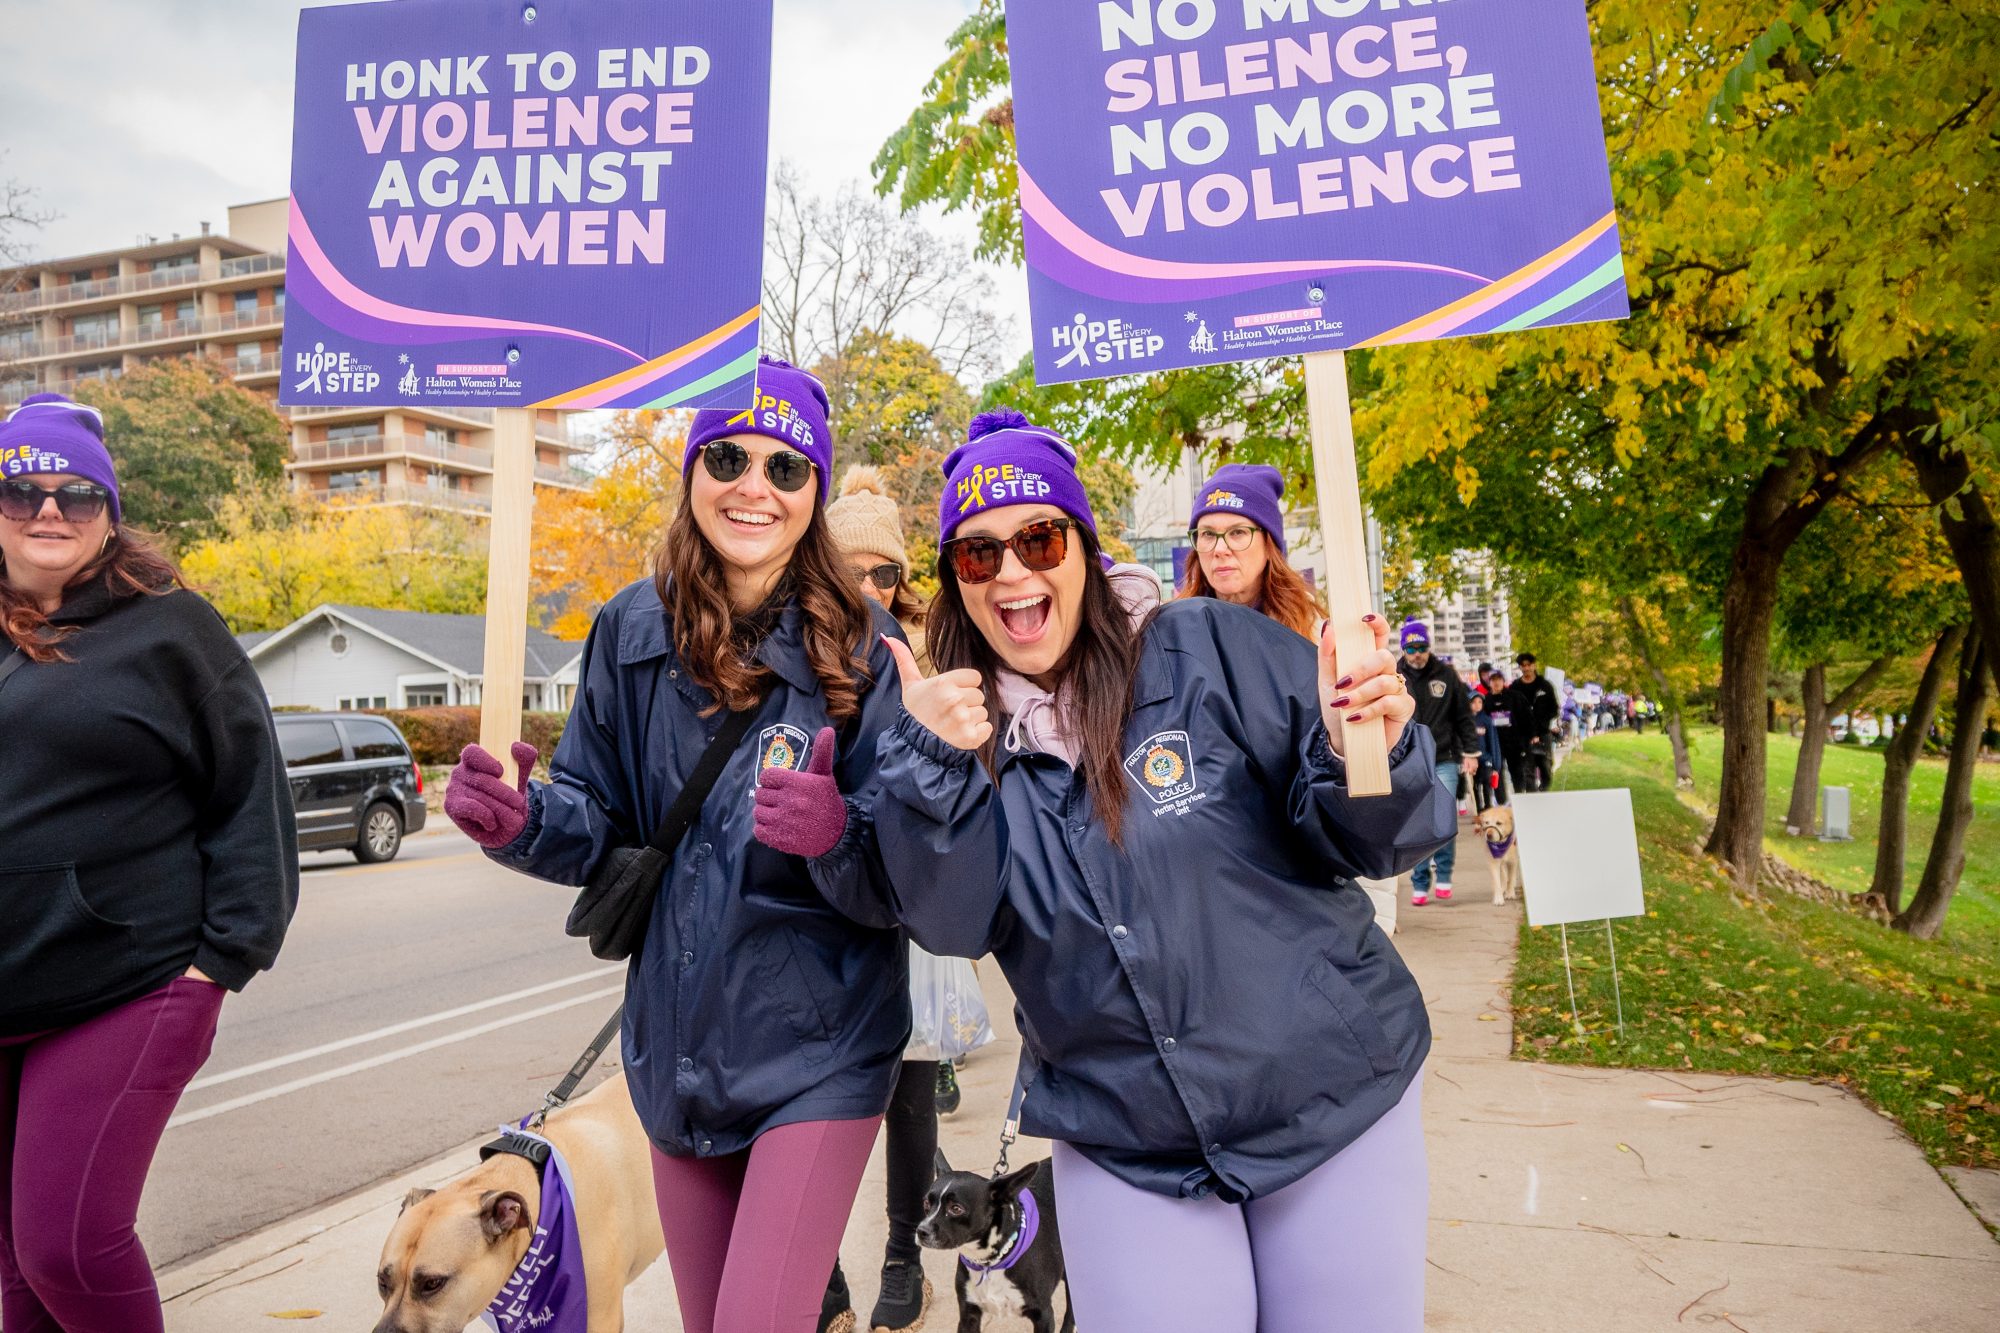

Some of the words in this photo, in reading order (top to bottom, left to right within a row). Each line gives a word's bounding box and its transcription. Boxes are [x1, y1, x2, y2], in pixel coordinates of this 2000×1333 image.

[1098, 0, 1217, 52] NO
[345, 55, 491, 102] HONK
[506, 51, 577, 93] TO
[597, 45, 711, 89] END
[1104, 16, 1469, 113] SILENCE,
[353, 92, 695, 155] VIOLENCE
[1108, 111, 1230, 177] NO
[1254, 72, 1501, 157] MORE
[368, 150, 673, 209] AGAINST
[1100, 135, 1522, 239] VIOLENCE
[369, 209, 667, 269] WOMEN
[1123, 323, 1133, 331] IN
[1239, 316, 1249, 325] IN
[1254, 312, 1301, 324] SUPPORT
[1304, 309, 1316, 318] OF
[1123, 327, 1152, 339] EVERY
[1223, 328, 1262, 342] Halton
[1264, 323, 1312, 338] Women's
[1315, 319, 1343, 332] Place
[1224, 341, 1246, 350] Healthy
[1246, 337, 1281, 348] Relationships
[1285, 333, 1307, 344] Healthy
[1308, 331, 1344, 341] Communities
[1094, 335, 1165, 363] STEP
[326, 373, 380, 393] STEP
[426, 377, 457, 388] Halton
[460, 377, 497, 388] Women's
[499, 376, 522, 388] Place
[755, 395, 791, 418] PE
[762, 411, 814, 446] STEP
[9, 456, 69, 474] STEP
[957, 464, 1015, 499] HOPE
[991, 479, 1051, 500] STEP
[1127, 746, 1148, 768] HALTON
[1155, 734, 1186, 745] REGIONAL
[1158, 782, 1192, 800] POLICE
[1152, 803, 1176, 818] Victim
[1176, 792, 1207, 808] Services
[1175, 806, 1191, 817] Unit
